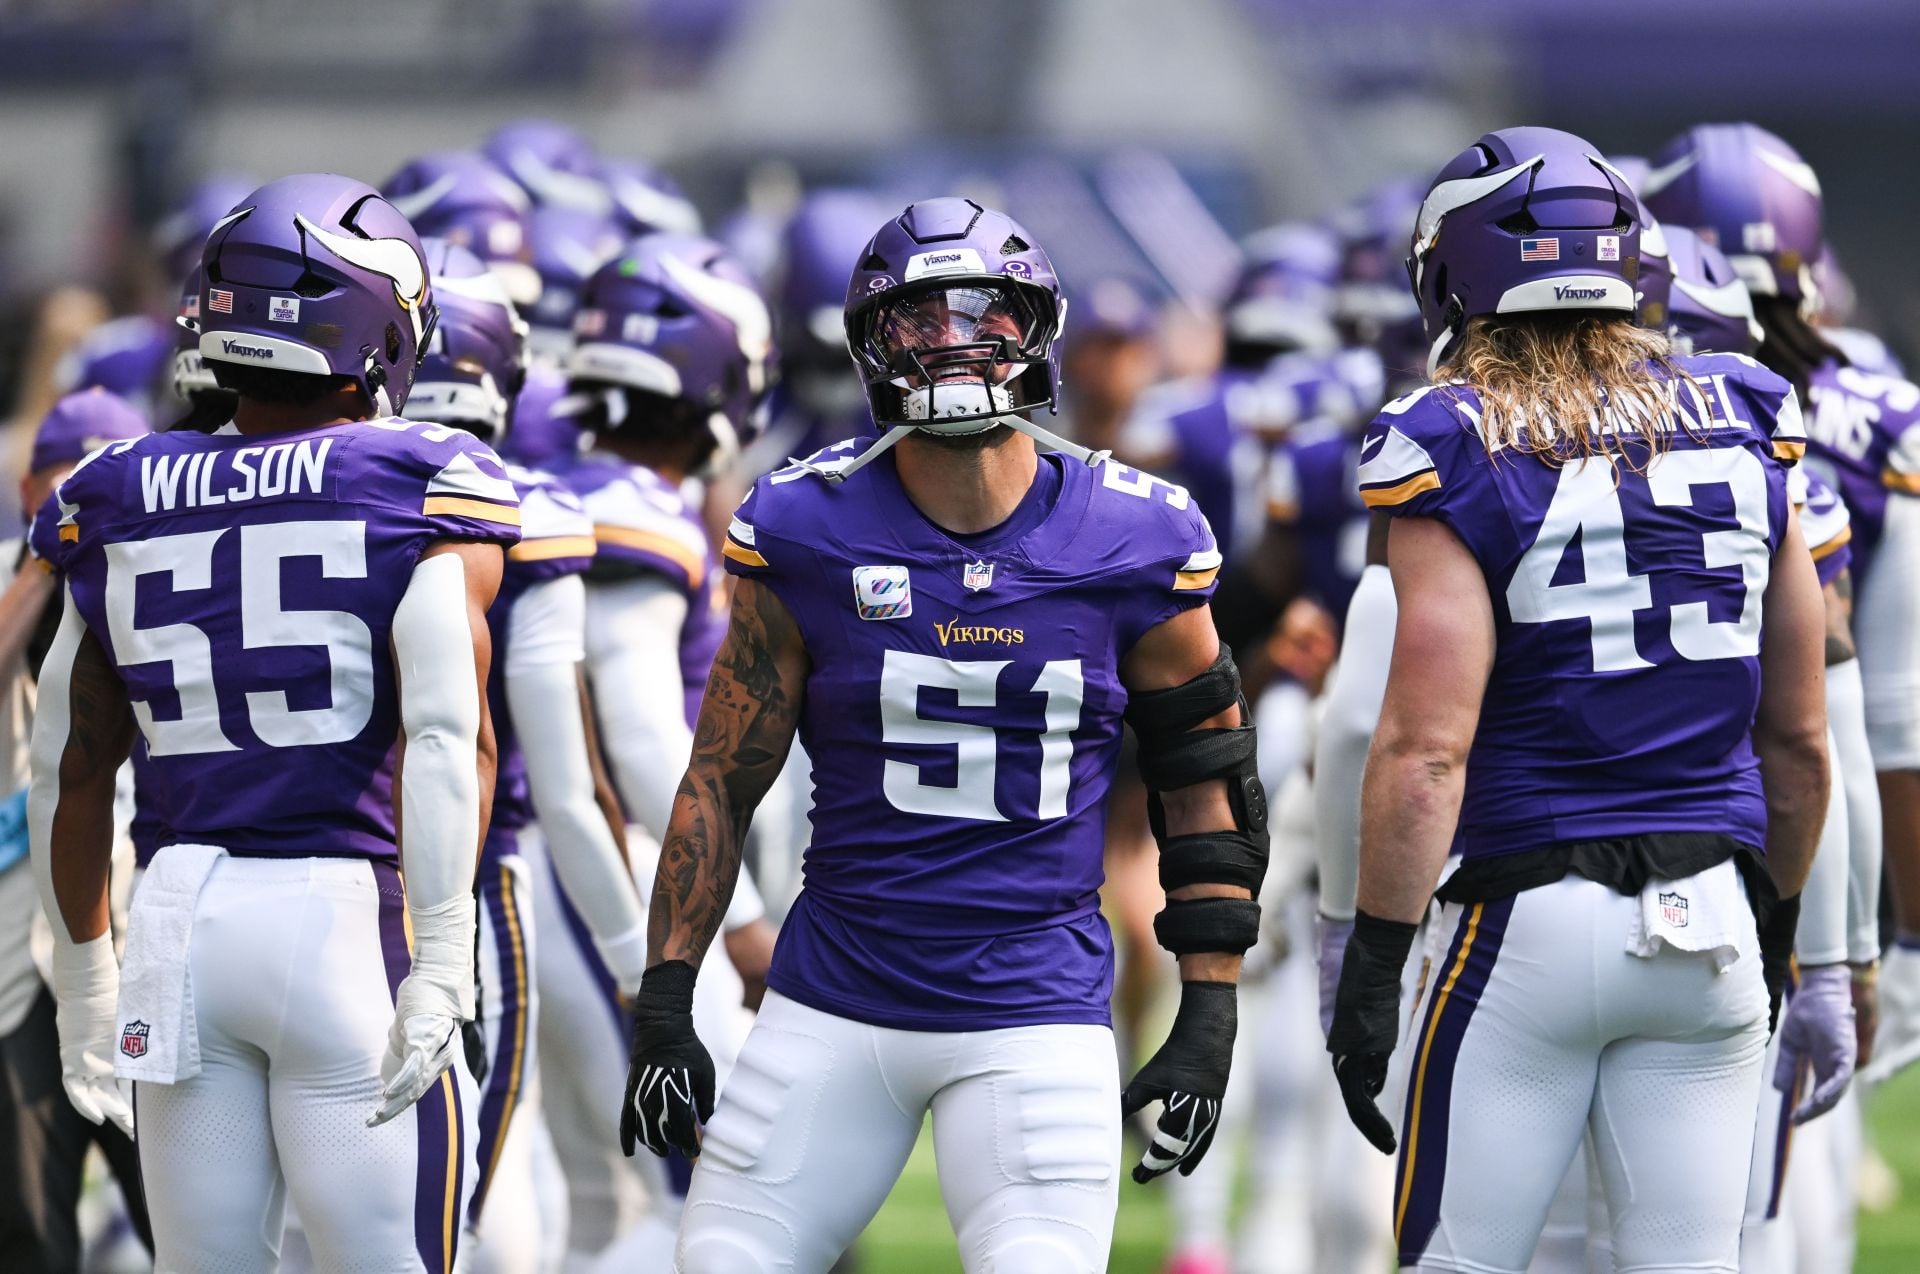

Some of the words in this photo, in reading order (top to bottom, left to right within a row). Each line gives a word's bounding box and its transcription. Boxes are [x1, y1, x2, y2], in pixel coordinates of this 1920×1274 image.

[1553, 283, 1607, 301] VIKINGS
[221, 338, 274, 359] VIKINGS
[141, 438, 334, 514] WILSON
[1505, 445, 1770, 672] 43
[968, 573, 987, 586] NFL
[103, 520, 375, 758] 55
[933, 614, 1025, 647] VIKINGS
[880, 648, 1084, 822] 51
[1663, 906, 1685, 924] NFL
[123, 1035, 144, 1054] NFL
